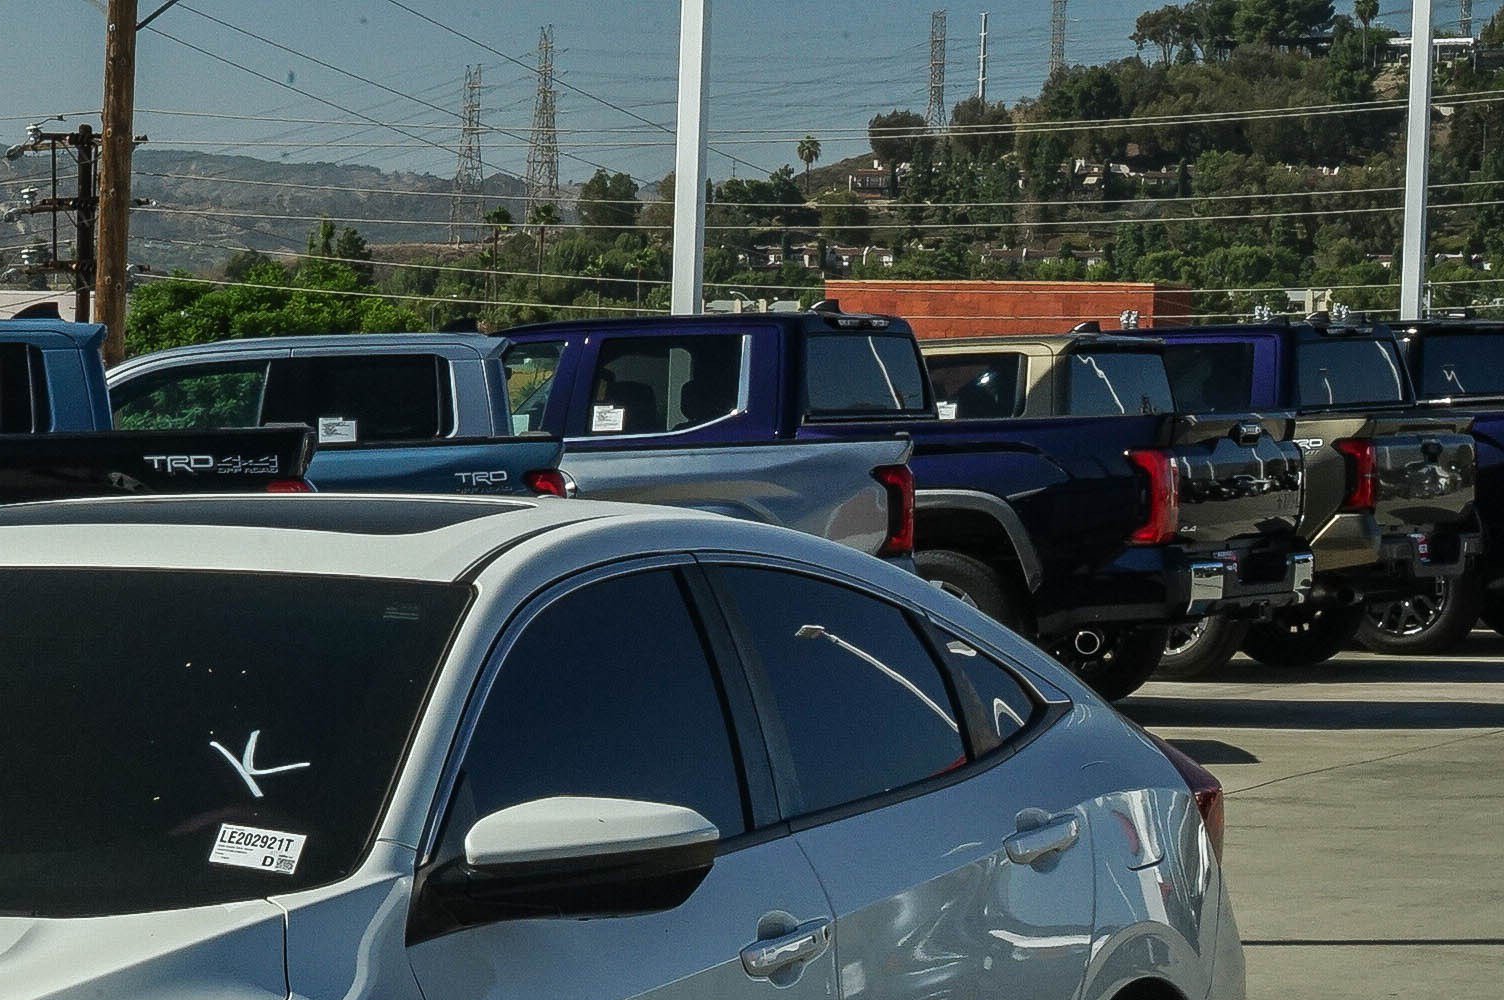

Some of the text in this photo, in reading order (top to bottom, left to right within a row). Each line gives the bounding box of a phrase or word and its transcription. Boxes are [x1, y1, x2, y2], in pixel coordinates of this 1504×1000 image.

[143, 455, 214, 473] TRD
[454, 470, 508, 486] TRD
[219, 829, 295, 852] LE202921T
[261, 855, 275, 867] D
